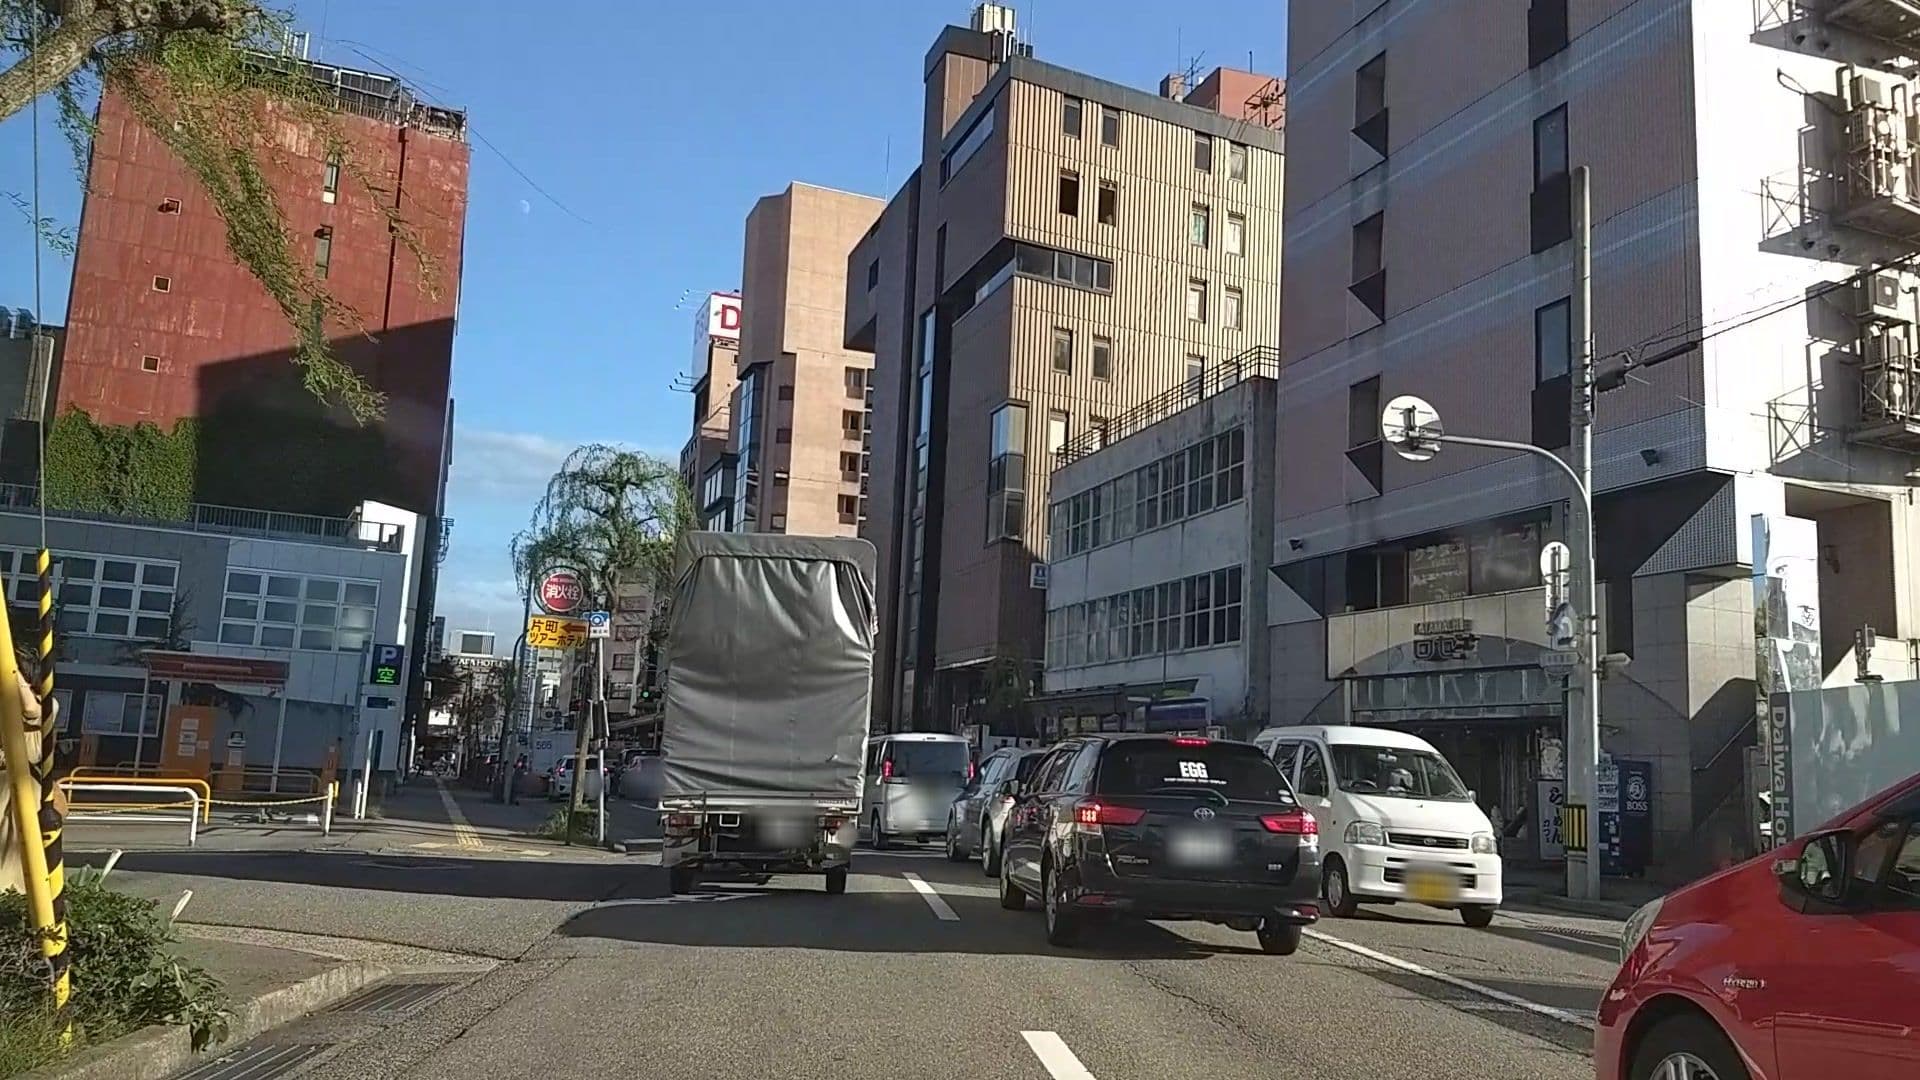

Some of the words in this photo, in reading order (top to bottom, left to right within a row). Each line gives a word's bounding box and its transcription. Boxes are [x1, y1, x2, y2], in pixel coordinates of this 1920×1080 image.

[546, 584, 579, 600] 消火栓
[531, 620, 558, 633] 片町
[529, 633, 585, 647] ツアーホテル
[380, 647, 397, 664] P
[376, 667, 395, 683] 空
[1772, 706, 1790, 793] Daiwa
[1179, 761, 1208, 779] EGG
[1626, 801, 1648, 811] BOSS
